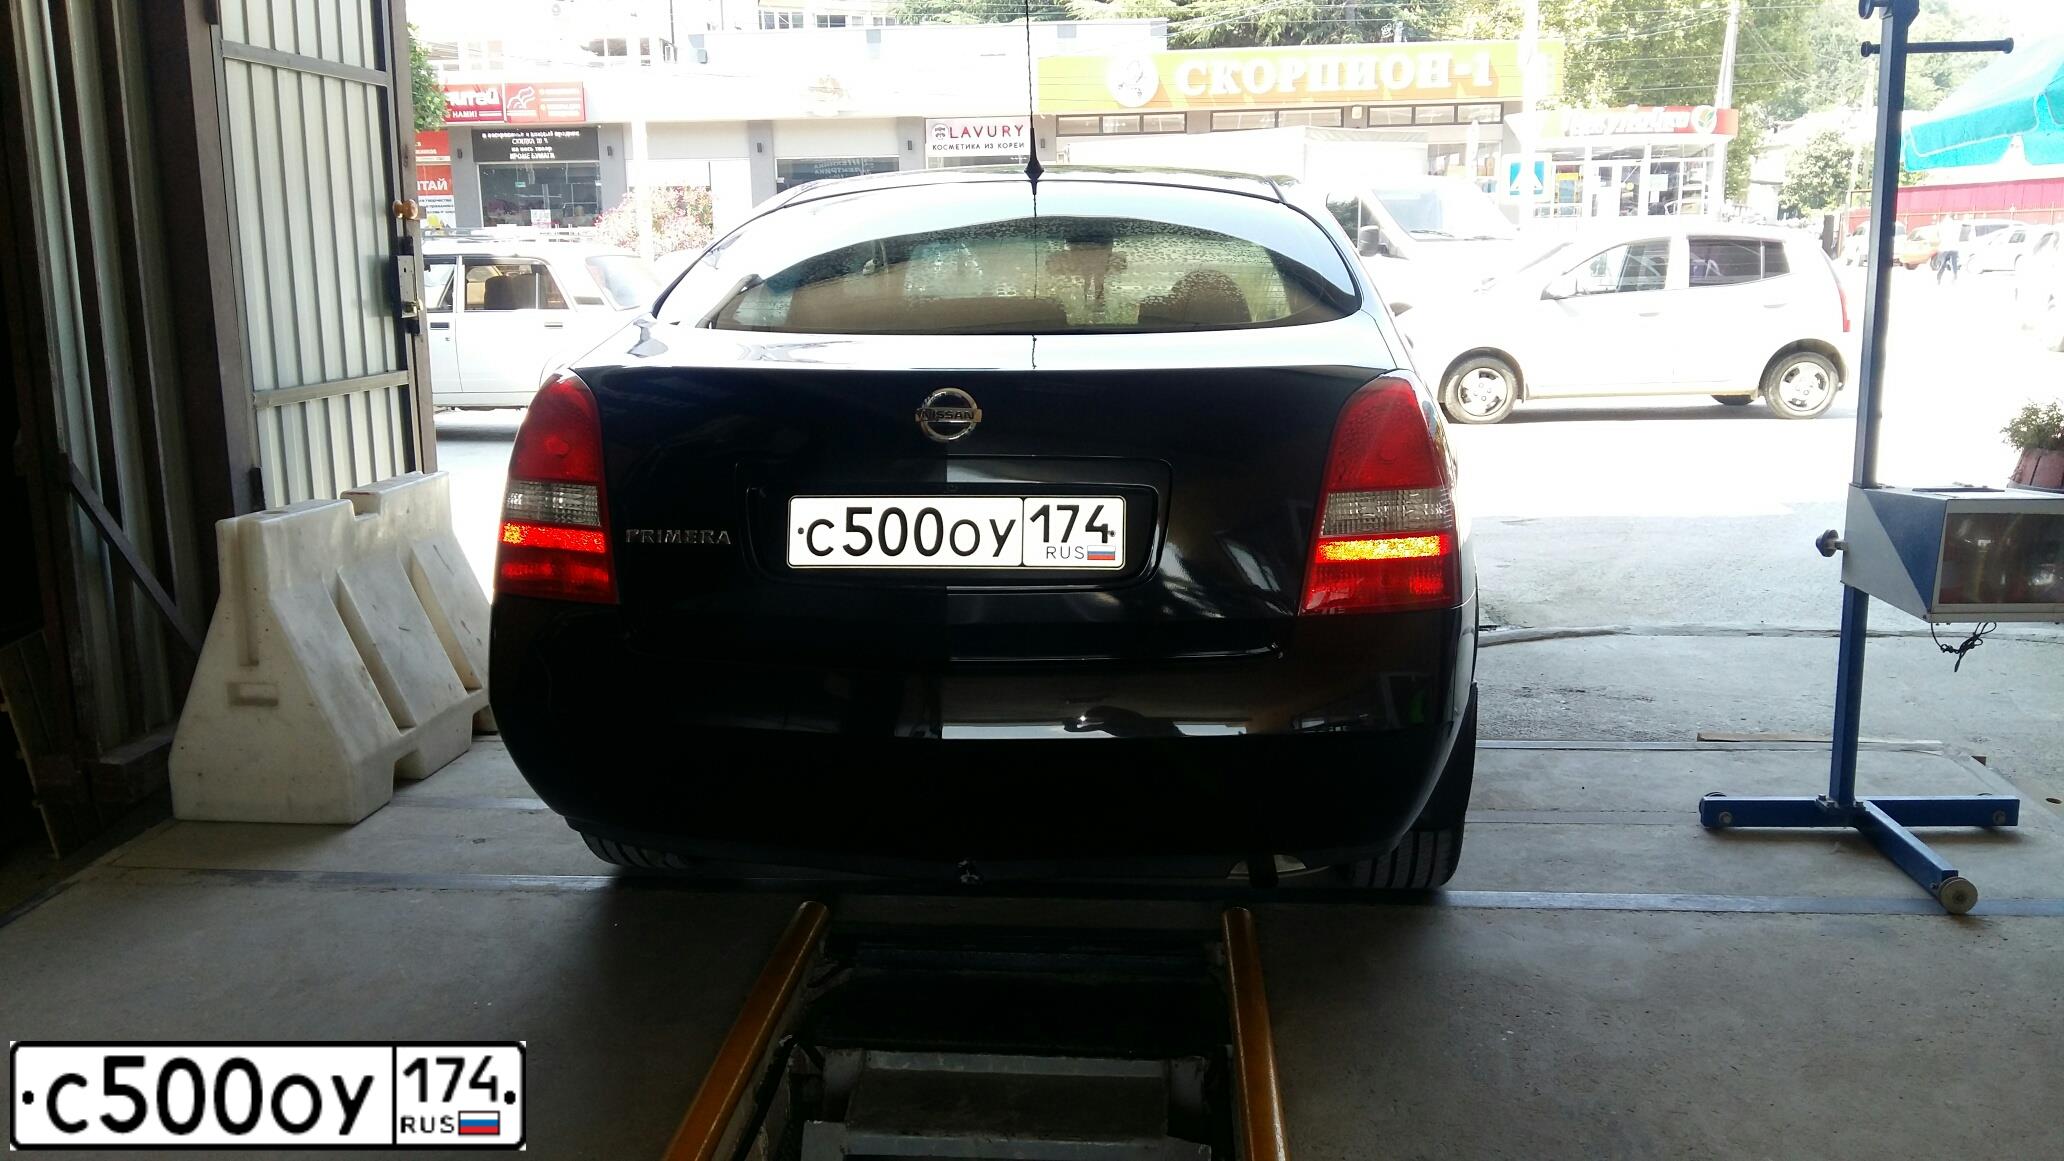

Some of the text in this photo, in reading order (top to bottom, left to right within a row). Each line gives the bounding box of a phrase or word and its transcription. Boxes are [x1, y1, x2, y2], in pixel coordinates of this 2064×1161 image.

[1175, 53, 1493, 97] СКОРПИОН-1
[949, 124, 1024, 139] LAVURY
[932, 143, 981, 151] КОСМЕТИКА
[920, 409, 975, 421] NISSAN
[1029, 504, 1109, 544] 174
[625, 528, 732, 544] PRIMERA
[1045, 546, 1085, 560] RUS
